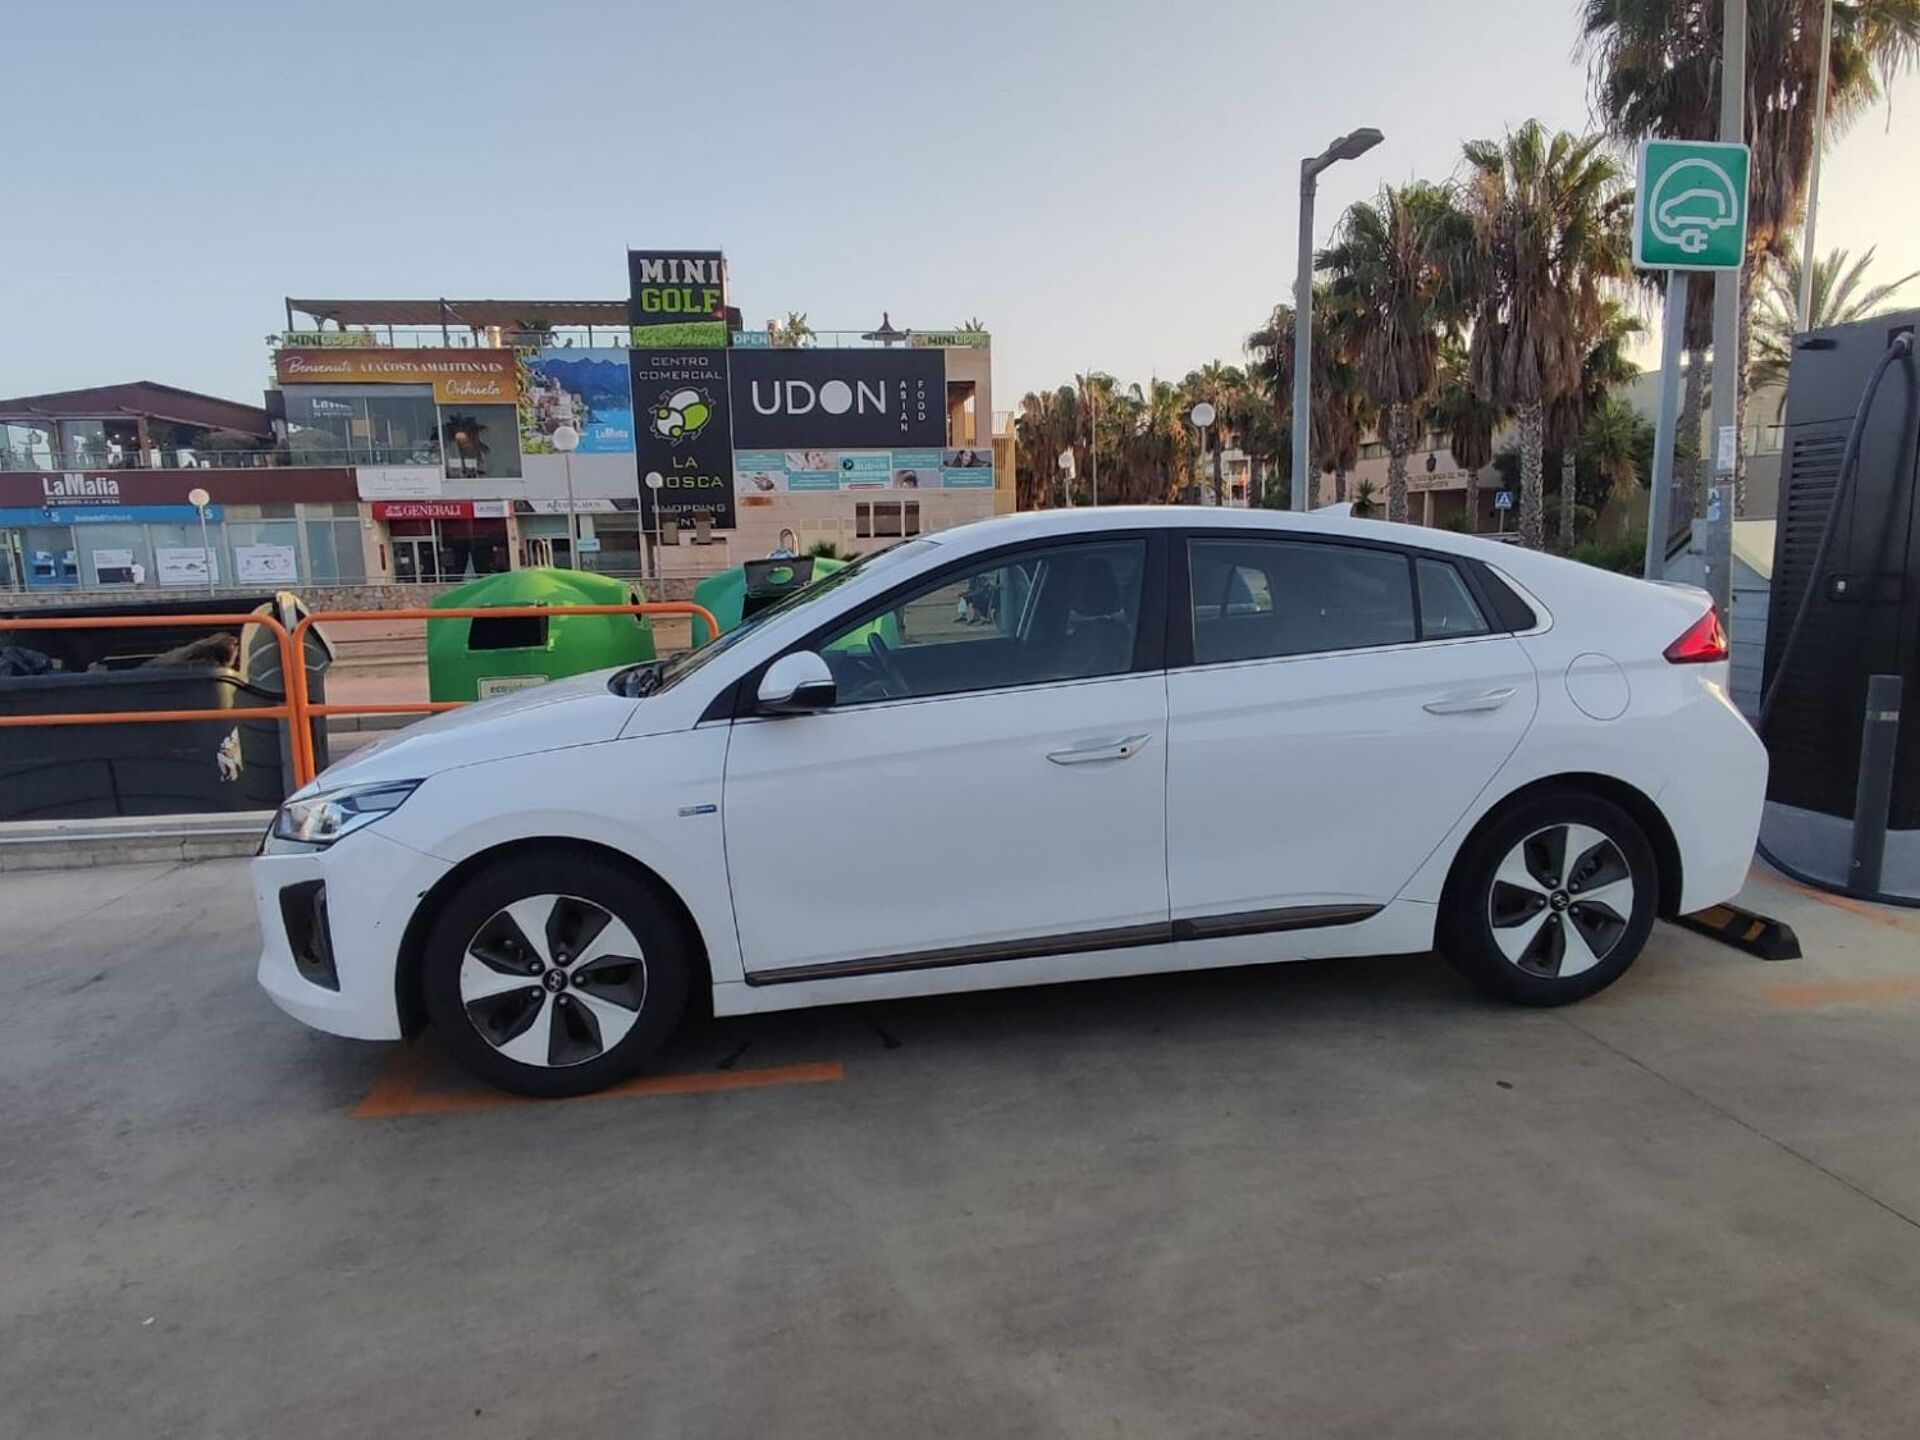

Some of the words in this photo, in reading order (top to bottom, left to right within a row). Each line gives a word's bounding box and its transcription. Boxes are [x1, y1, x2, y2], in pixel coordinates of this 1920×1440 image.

[639, 258, 720, 284] MINI
[640, 287, 721, 313] GOLF
[733, 333, 769, 346] OPEN
[650, 356, 709, 366] CENTRO
[639, 370, 723, 381] COMERCIAL
[751, 379, 887, 415] UDON
[899, 380, 908, 432] ASIAN
[917, 379, 926, 421] FOOD
[672, 456, 698, 468] LA
[42, 473, 119, 496] LaMafia
[664, 475, 724, 488] OSCA
[401, 503, 461, 517] GENERALI
